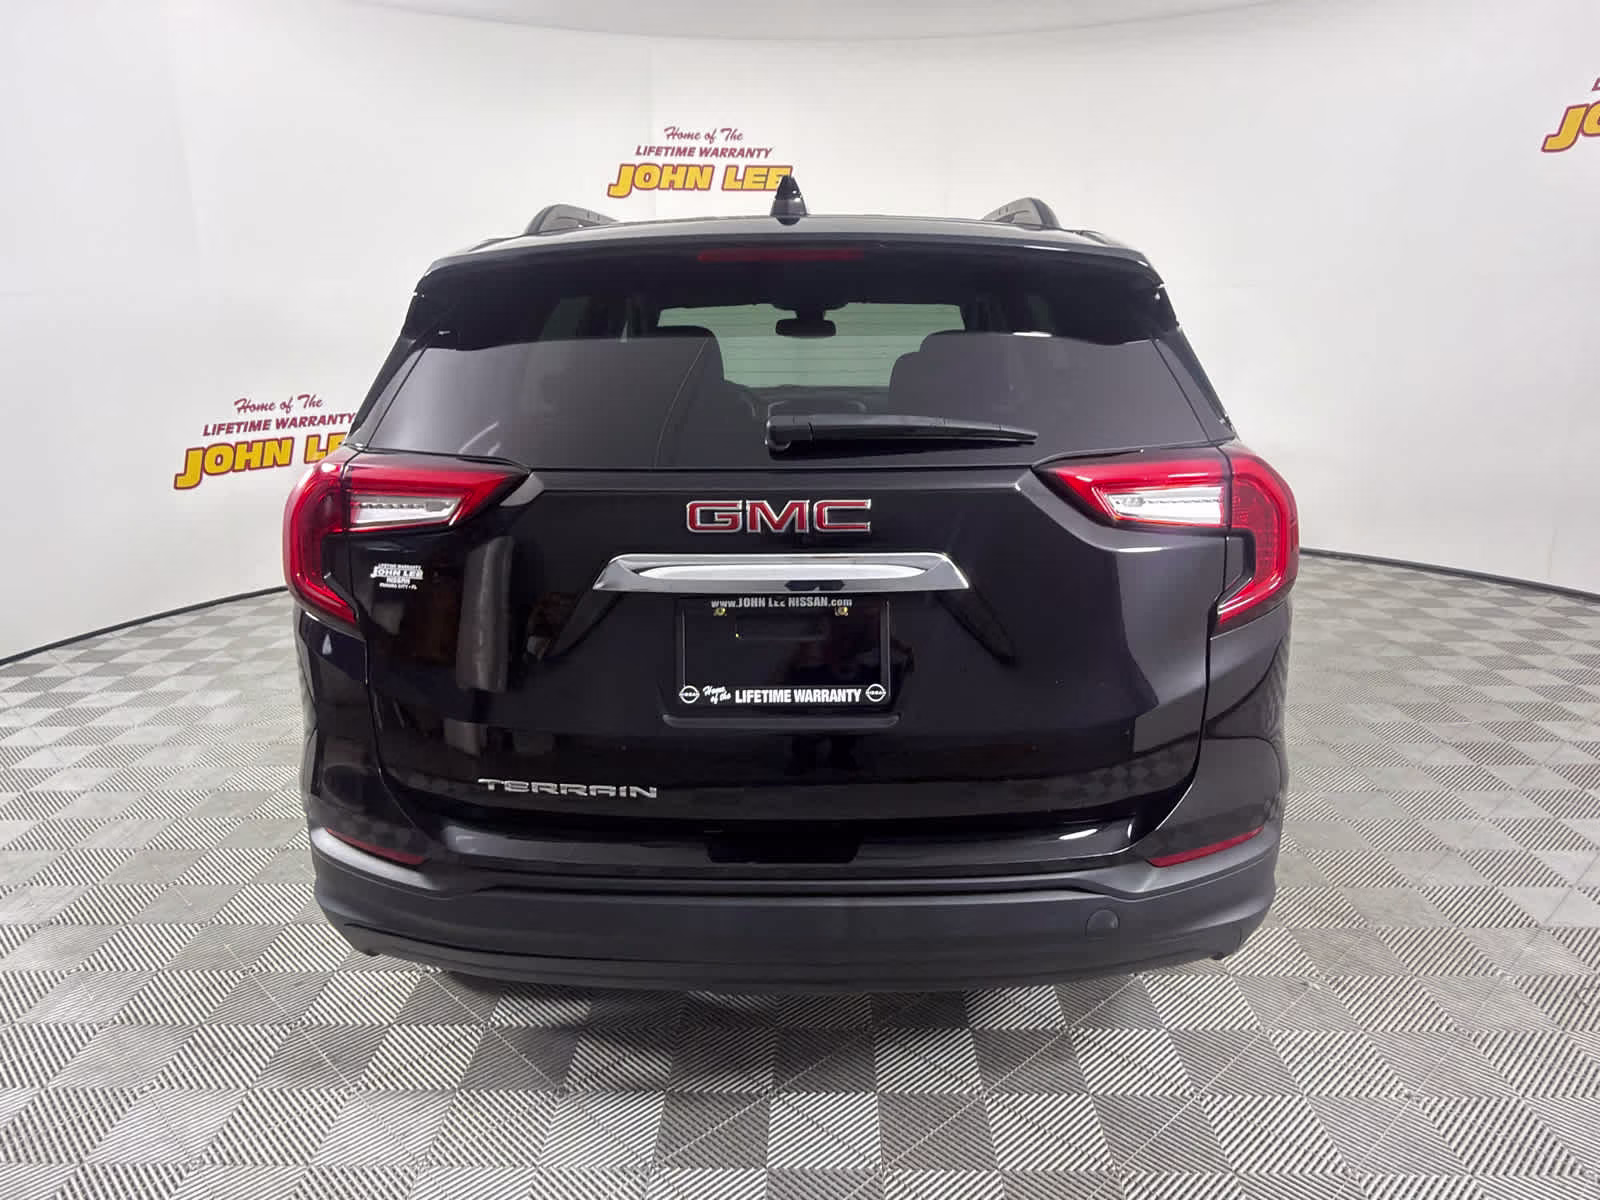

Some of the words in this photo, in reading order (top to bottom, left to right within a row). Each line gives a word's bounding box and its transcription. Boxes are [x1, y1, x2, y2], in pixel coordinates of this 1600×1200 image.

[664, 126, 700, 141] Home
[704, 129, 717, 144] of
[721, 128, 743, 142] The
[635, 145, 696, 157] LIFETIME
[699, 147, 772, 158] WARRANTY
[607, 163, 715, 198] JOHN
[721, 165, 793, 191] LEE
[234, 398, 275, 414] Home
[280, 399, 293, 414] of
[298, 394, 323, 409] The
[202, 419, 272, 437] LIFETIME
[275, 412, 356, 430] WARRANTY
[174, 437, 295, 490] JOHN
[686, 499, 872, 533] GMC
[370, 566, 401, 578] JOHN
[711, 597, 766, 608] www.JOHN
[788, 596, 853, 607] NISSAN.com
[735, 689, 792, 704] LIFETIME
[793, 688, 862, 703] WARRANTY
[478, 778, 657, 798] TERRAIN
